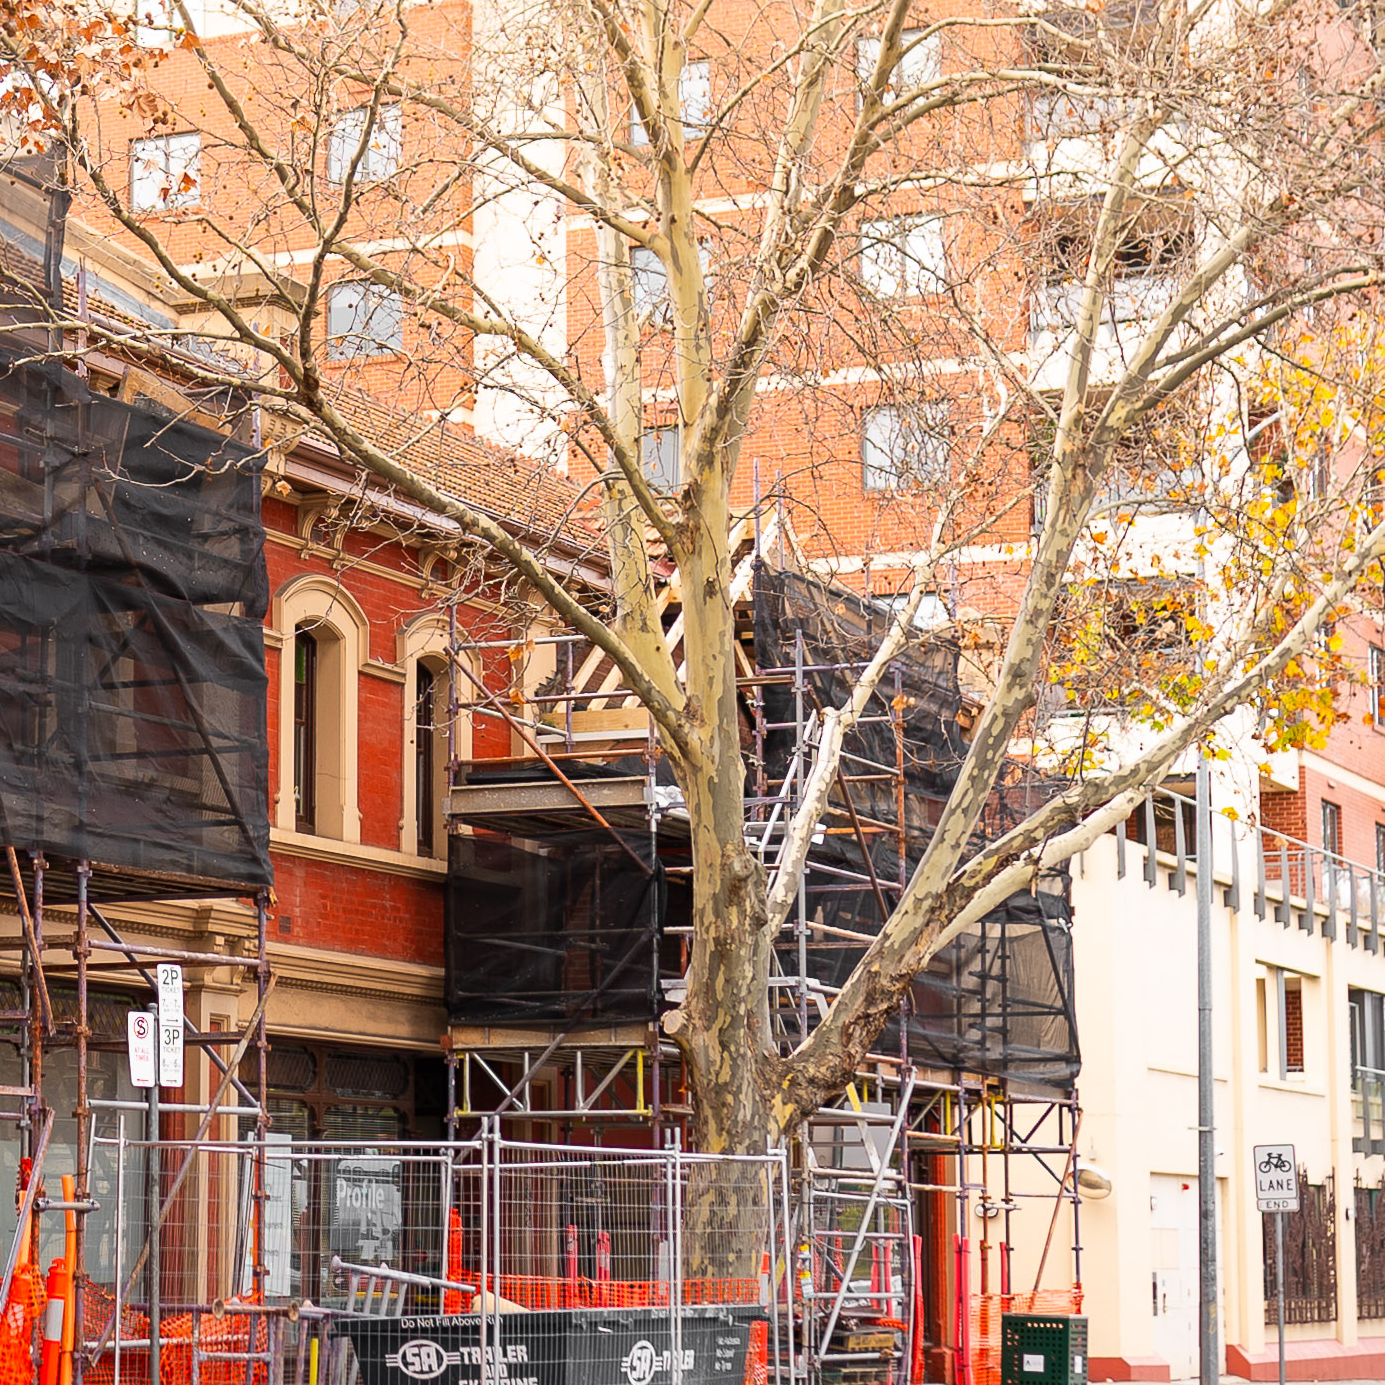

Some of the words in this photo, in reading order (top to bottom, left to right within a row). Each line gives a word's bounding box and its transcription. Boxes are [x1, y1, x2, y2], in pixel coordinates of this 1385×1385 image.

[162, 969, 179, 985] 2P
[164, 1029, 180, 1045] 3P
[1259, 1178, 1293, 1191] LANE
[336, 1178, 385, 1209] Profile
[1266, 1200, 1289, 1209] END
[401, 1317, 415, 1328] Do
[417, 1317, 434, 1328] Not
[436, 1316, 450, 1327] Fill
[451, 1315, 482, 1327] Above
[405, 1346, 438, 1372] SA
